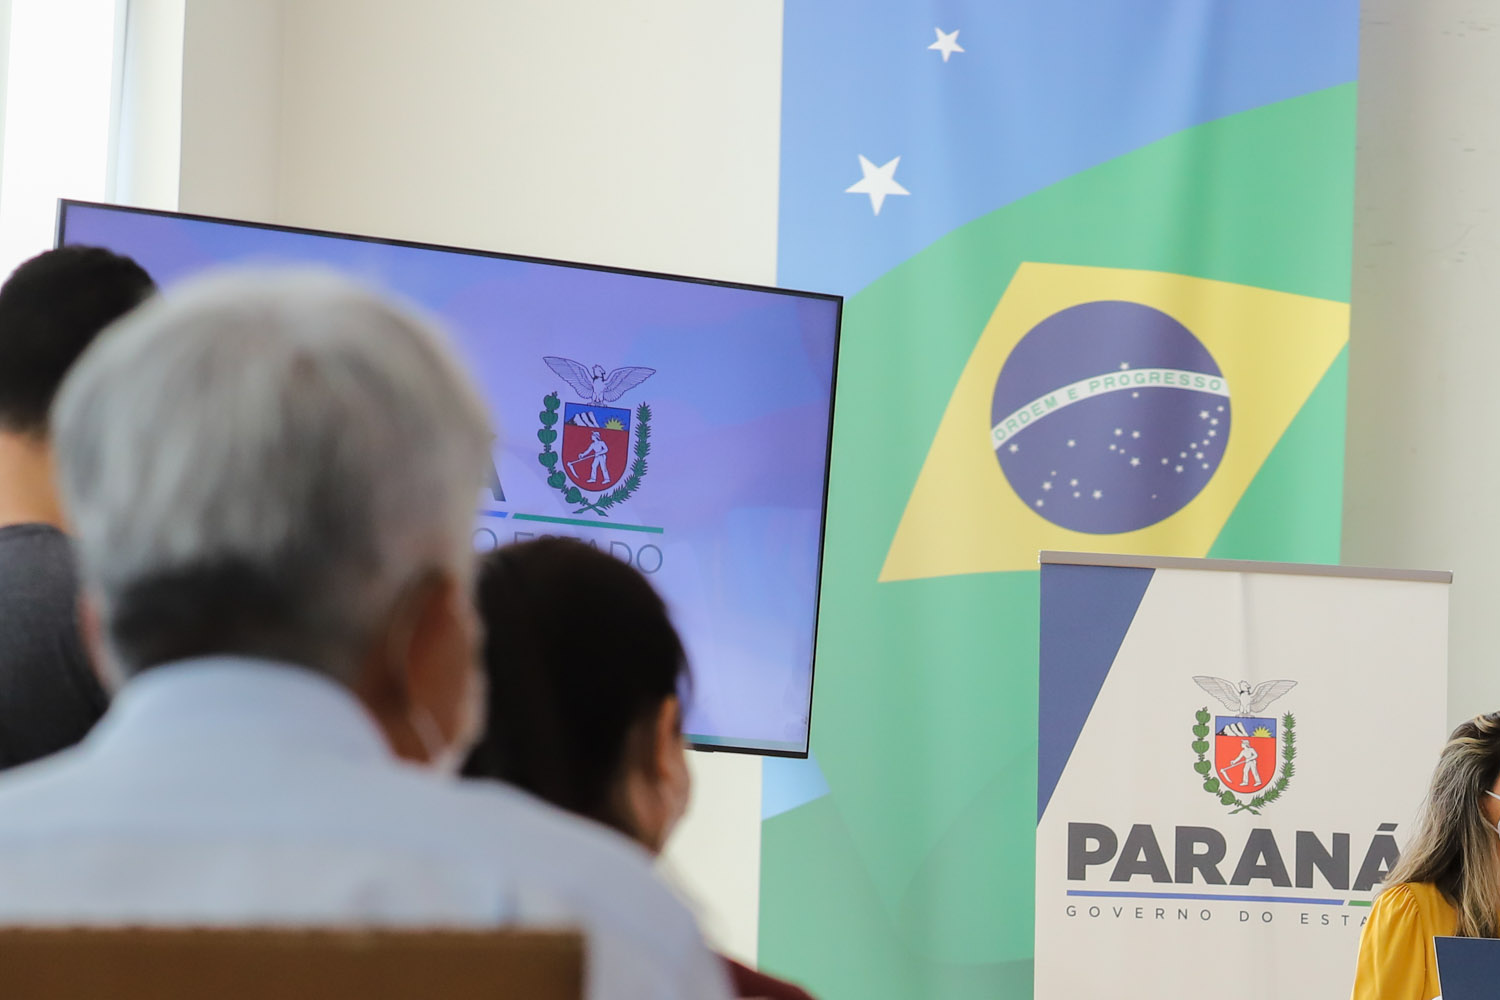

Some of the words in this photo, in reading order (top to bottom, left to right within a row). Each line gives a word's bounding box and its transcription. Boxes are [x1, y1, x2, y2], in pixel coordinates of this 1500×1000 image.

[994, 396, 1059, 442] ORDEM
[1067, 387, 1079, 400] E
[1088, 371, 1222, 393] PROGRESSO
[1066, 821, 1401, 892] PARANÁ
[1066, 904, 1212, 921] GOVERNO
[1239, 910, 1273, 923] DO
